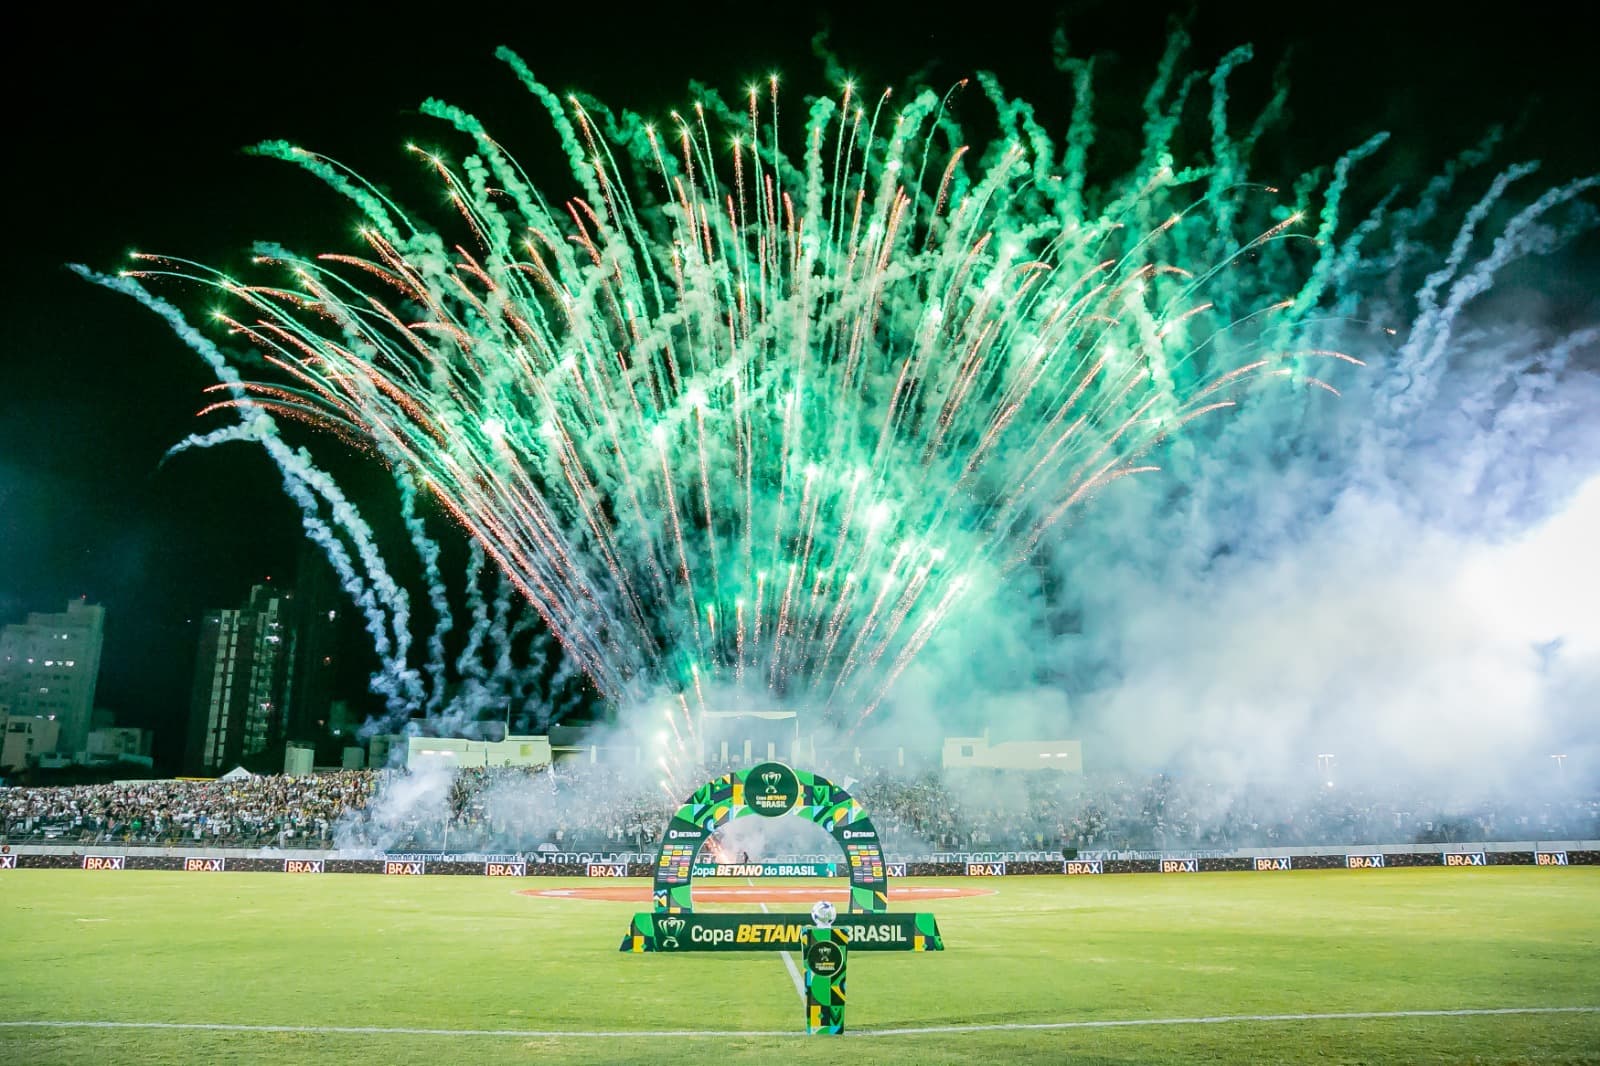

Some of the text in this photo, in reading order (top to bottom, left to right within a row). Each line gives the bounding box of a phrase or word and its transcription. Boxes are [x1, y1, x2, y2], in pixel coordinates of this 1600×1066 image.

[87, 858, 121, 869] BRAX
[188, 860, 220, 871] BRAX
[1257, 859, 1288, 870] BRAX
[1350, 857, 1381, 868] BRAX
[1448, 855, 1482, 866] BRAX
[1538, 854, 1565, 866] BRAX
[288, 861, 320, 873] BRAX
[388, 863, 420, 874] BRAX
[489, 865, 522, 876] BRAX
[591, 866, 624, 877] BRAX
[692, 865, 817, 878] Copa BETANO do BRASIL
[887, 866, 903, 876] AX
[970, 865, 1001, 876] BRAX
[1068, 863, 1099, 874] BRAX
[1164, 861, 1194, 872] BRAX
[691, 925, 733, 945] Copa
[736, 924, 808, 943] BETAN
